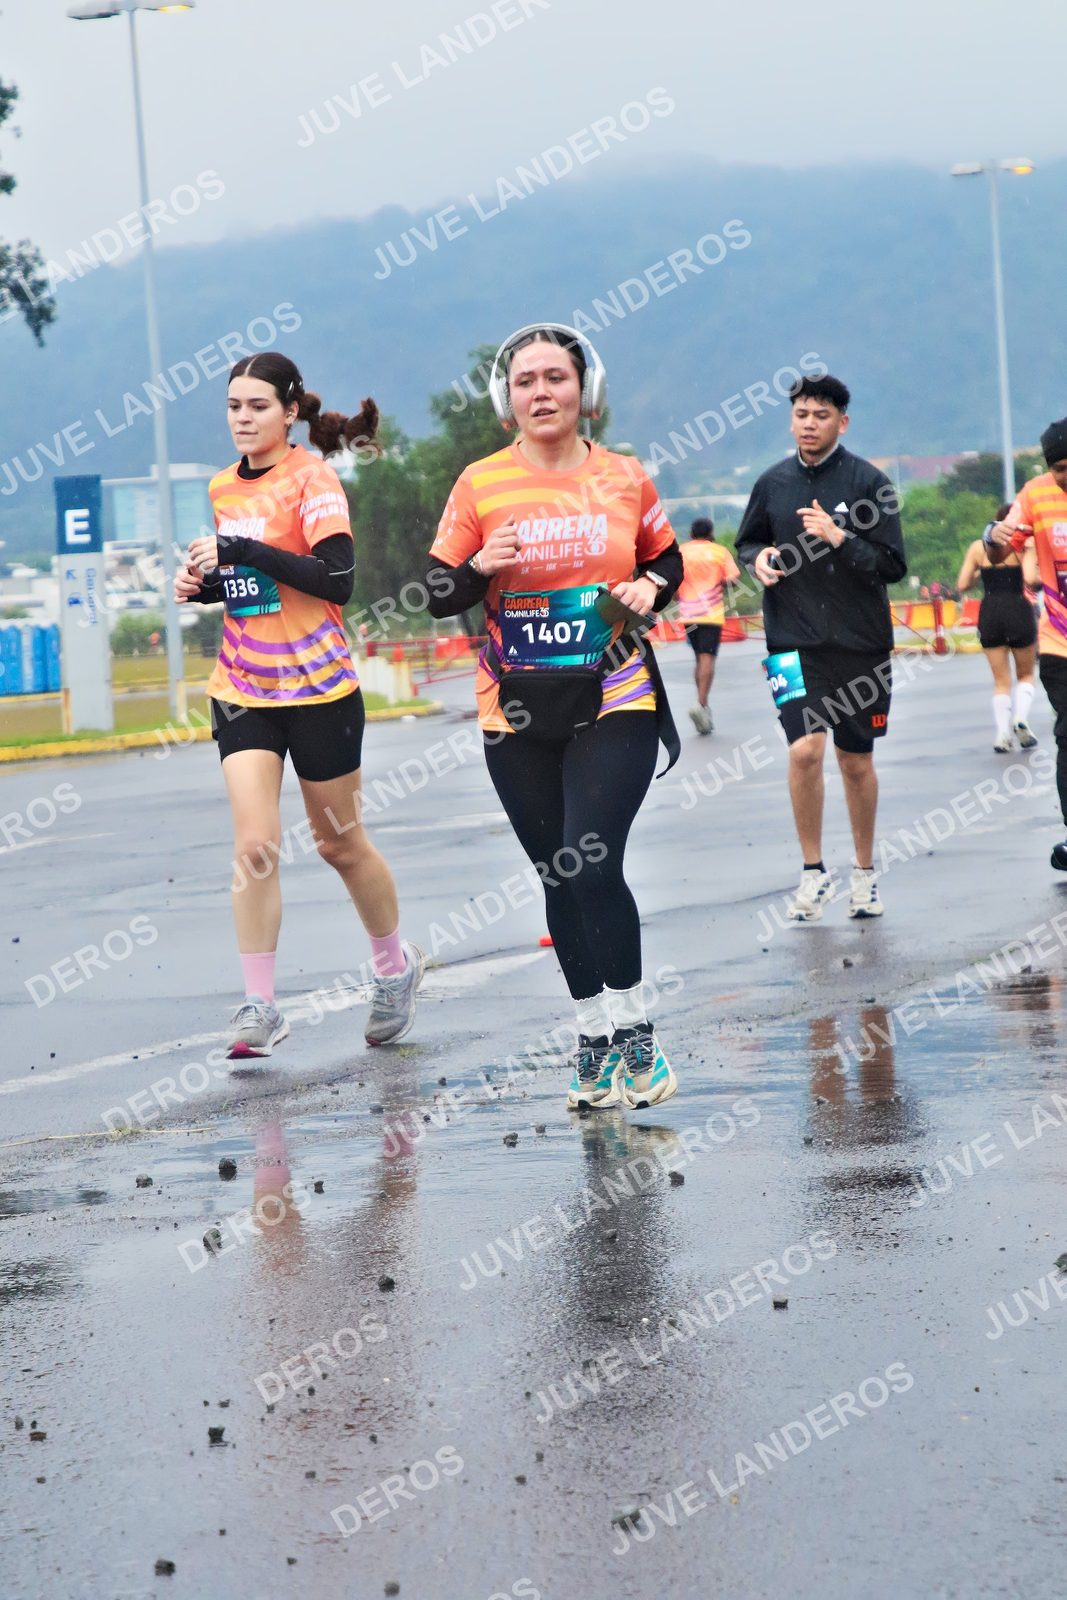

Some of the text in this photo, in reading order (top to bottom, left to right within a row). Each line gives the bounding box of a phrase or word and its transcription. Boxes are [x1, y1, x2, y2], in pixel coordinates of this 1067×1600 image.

[65, 508, 91, 545] E
[514, 514, 609, 544] ARRERA
[514, 542, 583, 563] MNILIFE
[224, 577, 259, 598] 1336
[505, 597, 549, 609] CARRERA
[522, 619, 586, 644] 1407
[768, 674, 788, 692] 04
